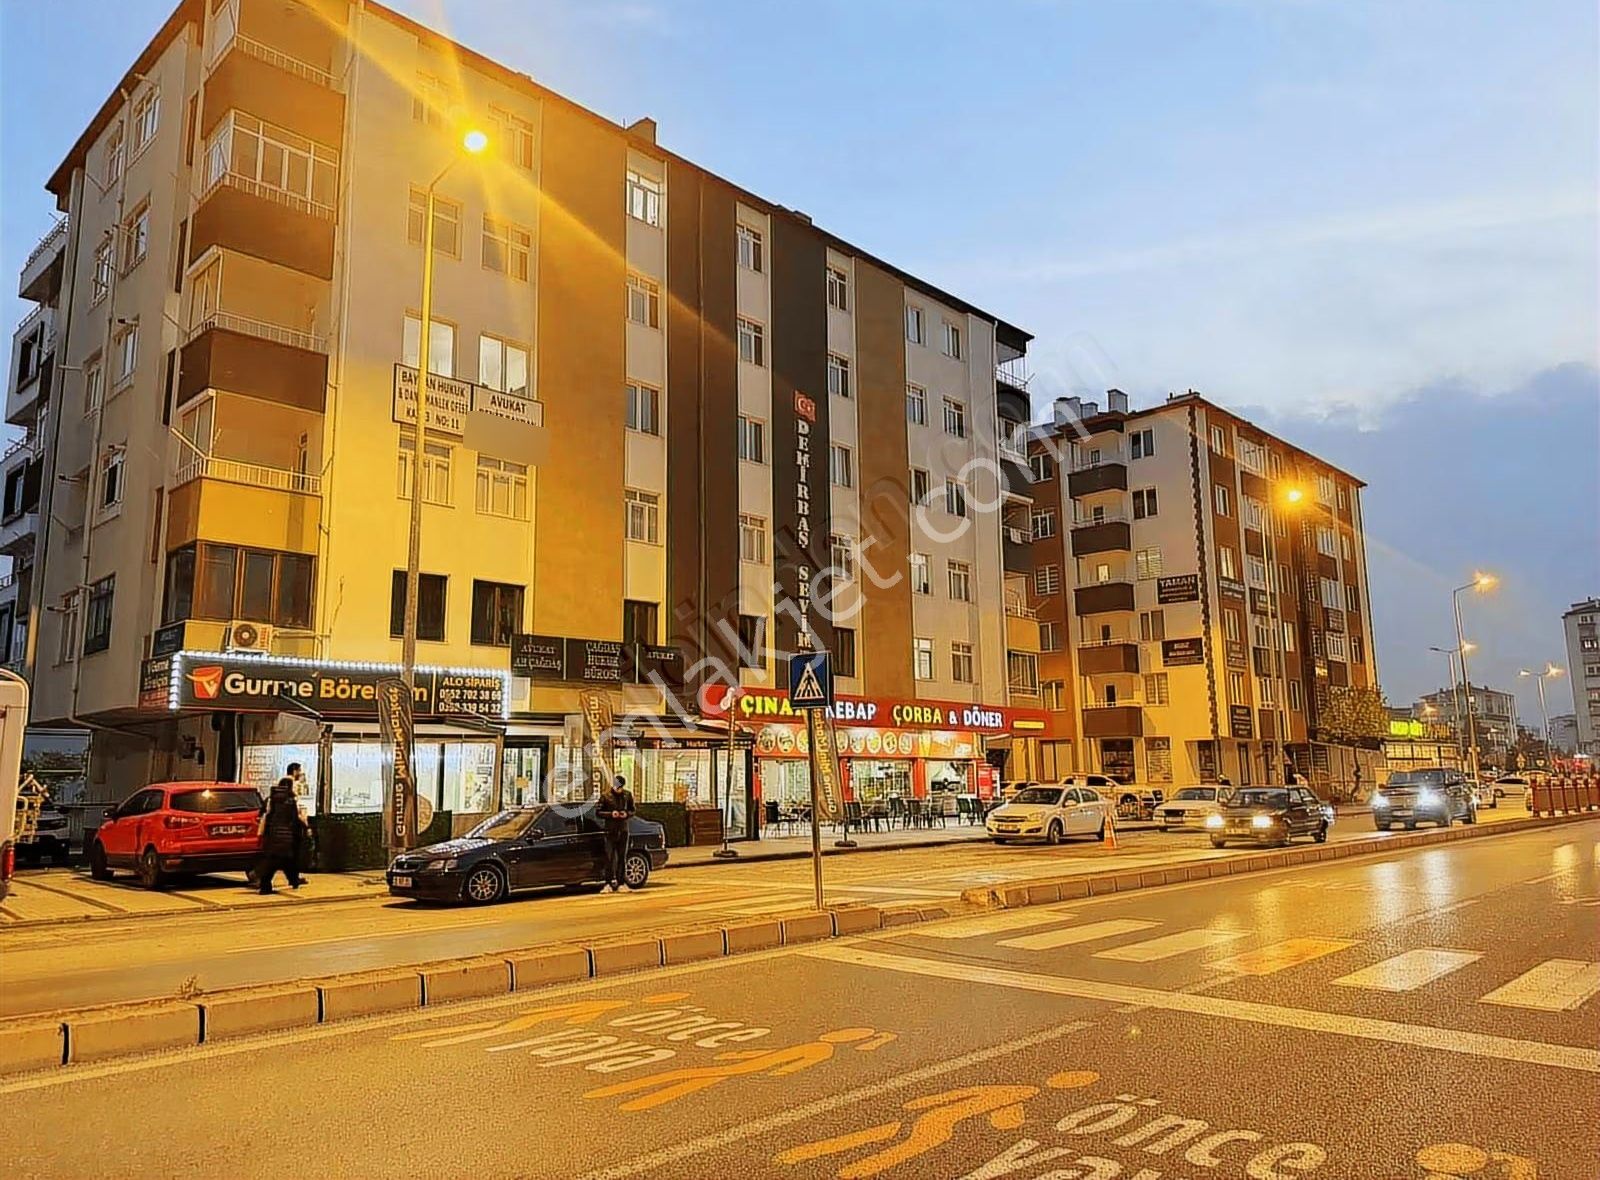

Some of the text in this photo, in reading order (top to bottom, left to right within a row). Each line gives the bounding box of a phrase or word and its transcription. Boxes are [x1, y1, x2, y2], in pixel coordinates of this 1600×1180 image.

[401, 370, 436, 391] BAYAN
[490, 394, 526, 414] AVUKAT
[795, 419, 811, 550] DEMİRBAŞ
[224, 672, 316, 697] Gurme
[442, 676, 501, 691] ALO SİPARİŞ
[740, 695, 804, 718] ÇINA
[893, 705, 943, 727] ÇORBA
[948, 711, 958, 725] &
[963, 706, 1003, 728] DÖNER
[606, 1006, 771, 1049] önce
[1055, 1093, 1328, 1180] önce
